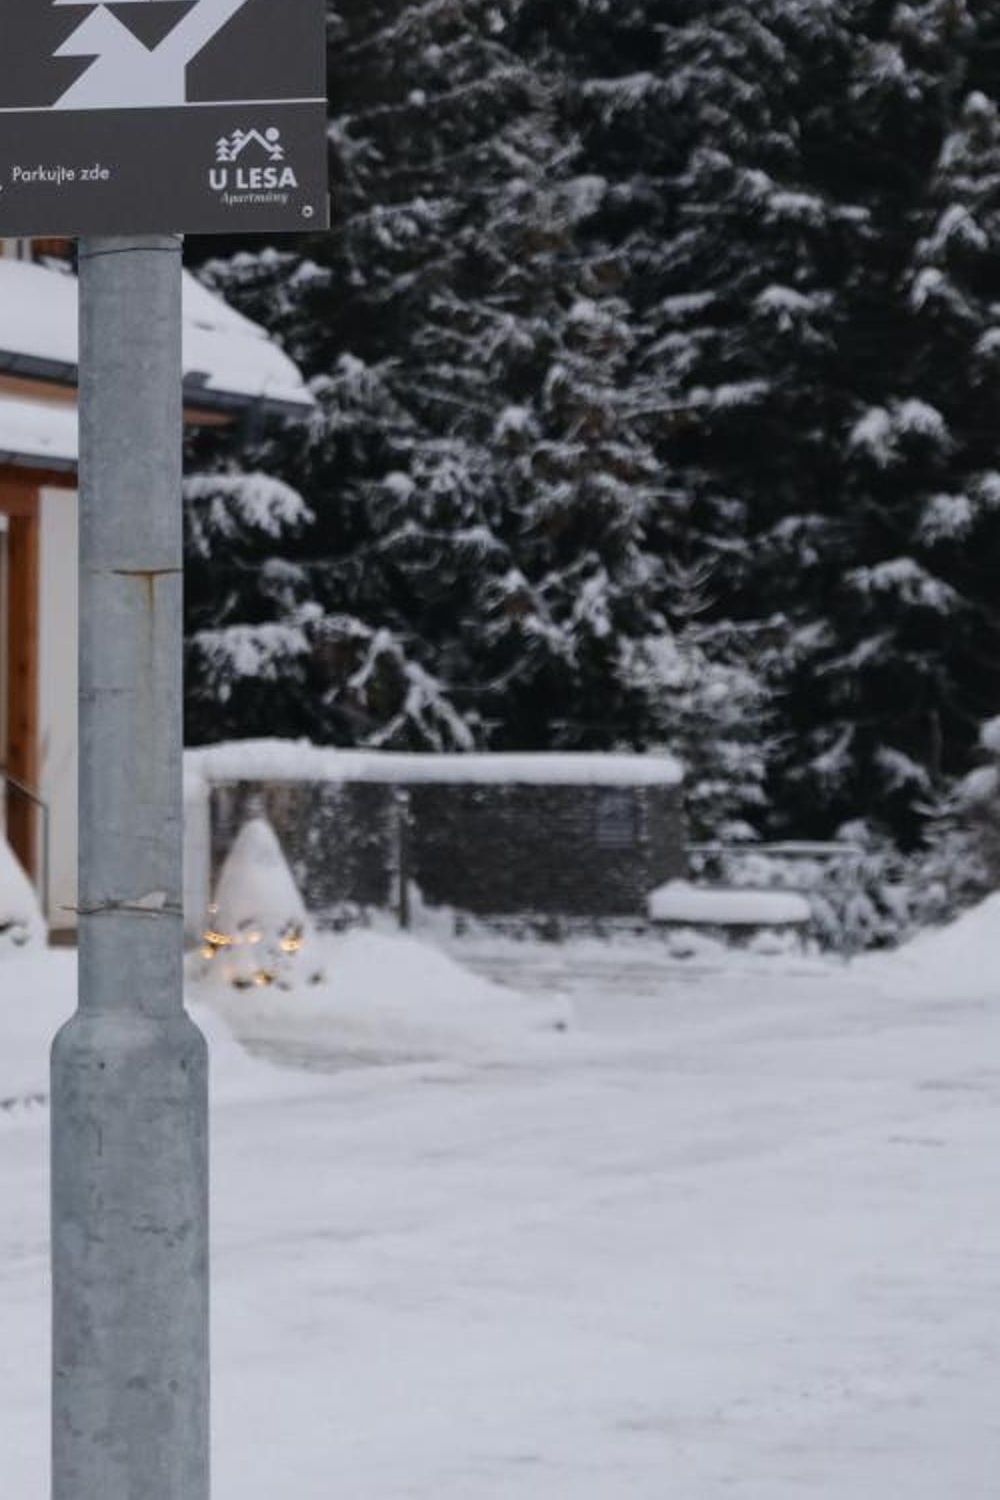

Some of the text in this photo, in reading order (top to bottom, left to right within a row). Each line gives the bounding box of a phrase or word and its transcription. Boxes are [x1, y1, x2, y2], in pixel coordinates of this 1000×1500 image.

[12, 162, 111, 186] Parkujte zde
[208, 165, 299, 191] U LESA
